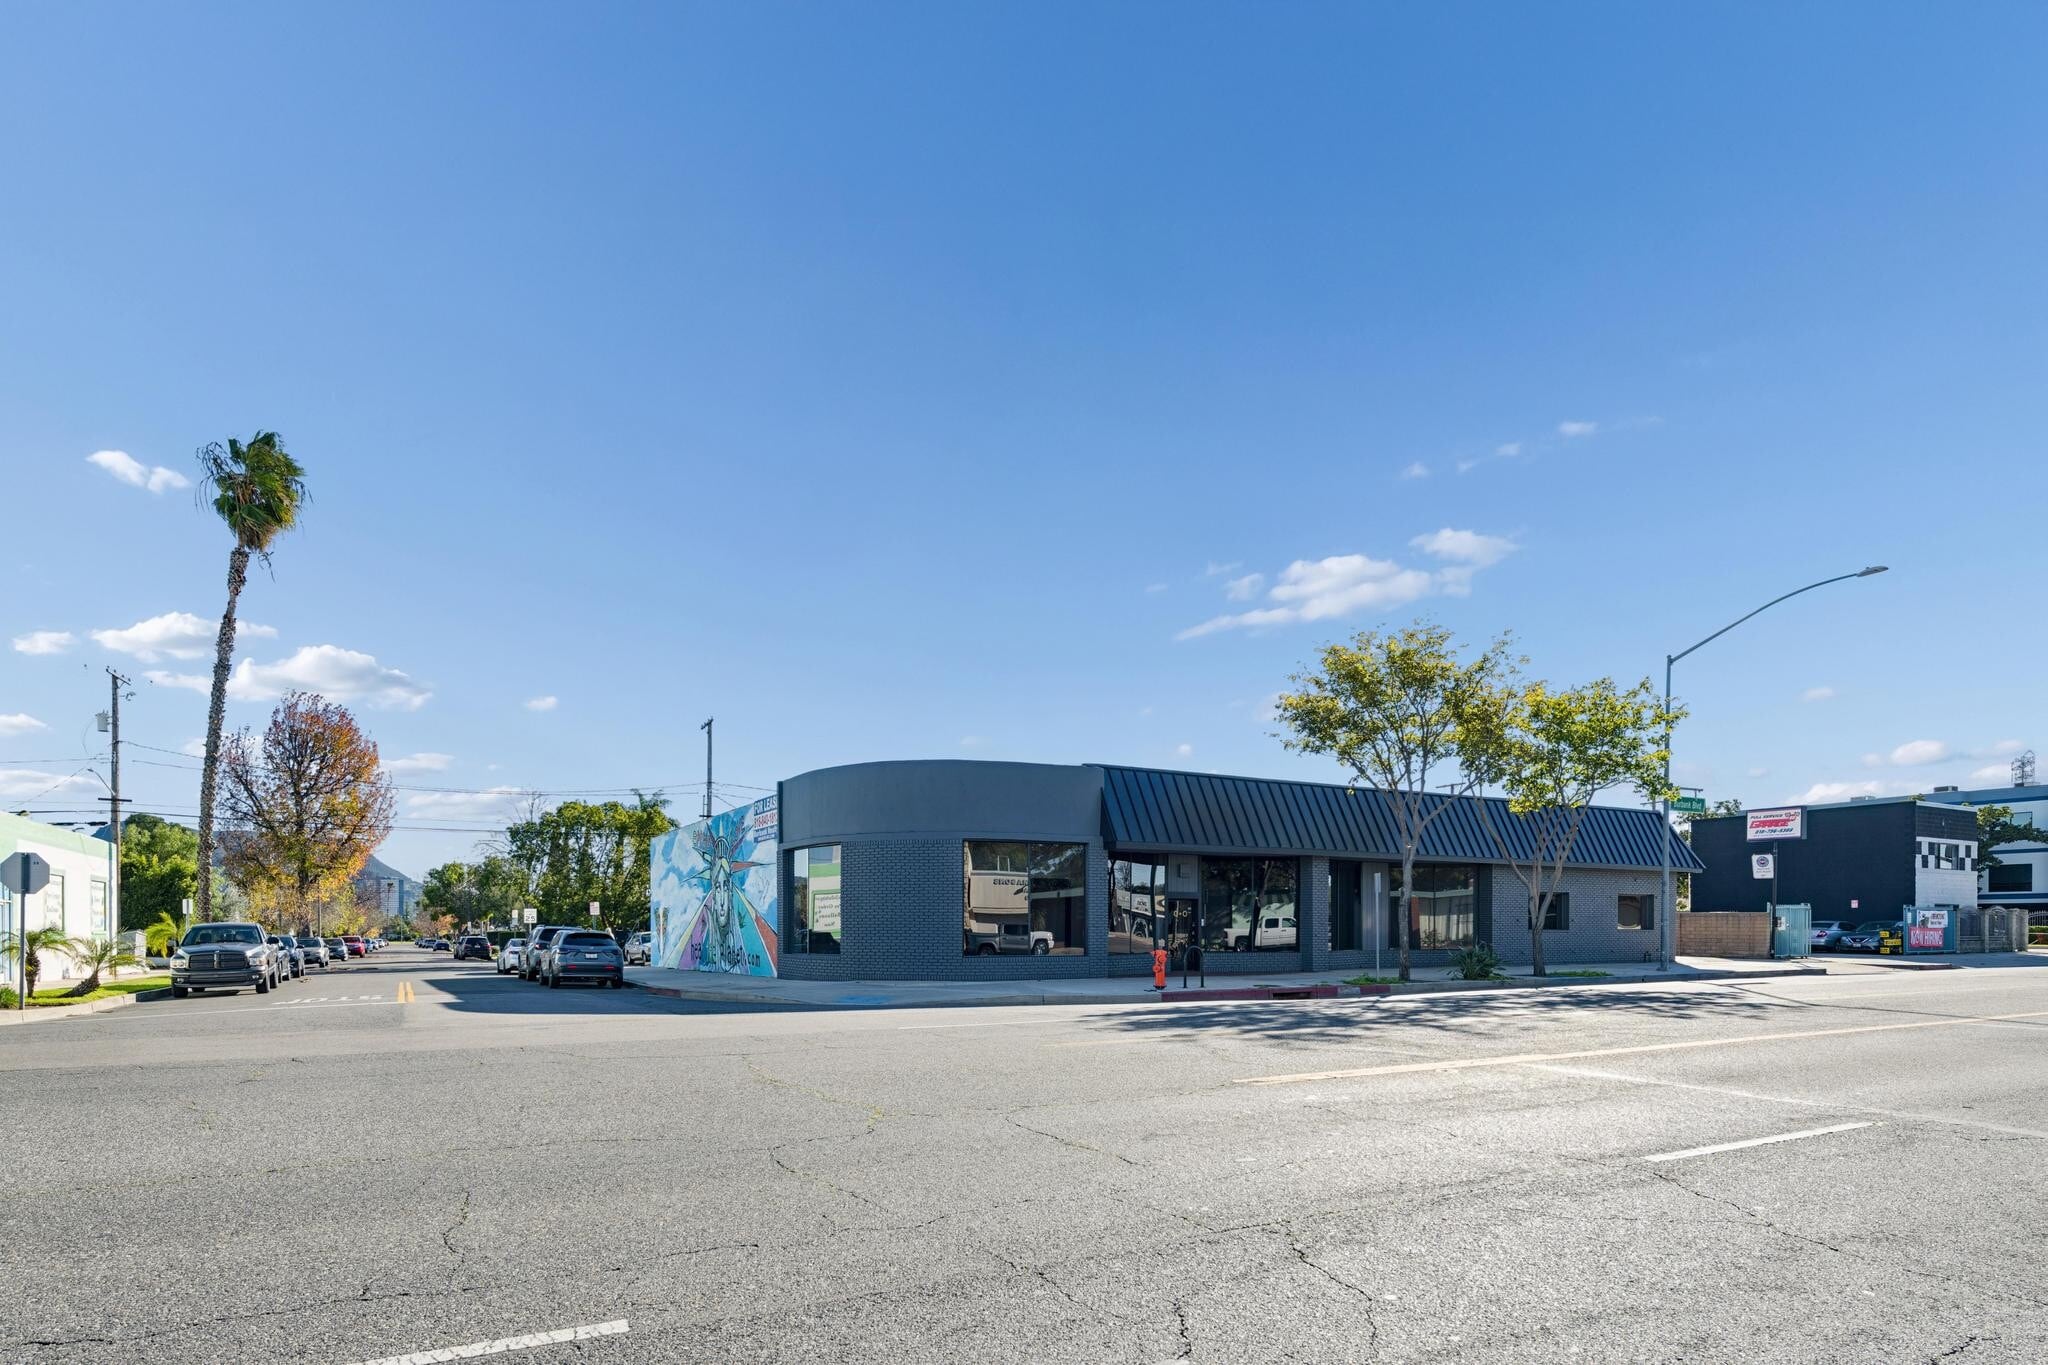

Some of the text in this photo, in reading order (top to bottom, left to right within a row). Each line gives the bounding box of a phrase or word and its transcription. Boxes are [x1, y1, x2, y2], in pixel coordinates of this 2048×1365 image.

[754, 796, 778, 815] FOR LEAS
[1910, 930, 1943, 945] NOW HIRING
